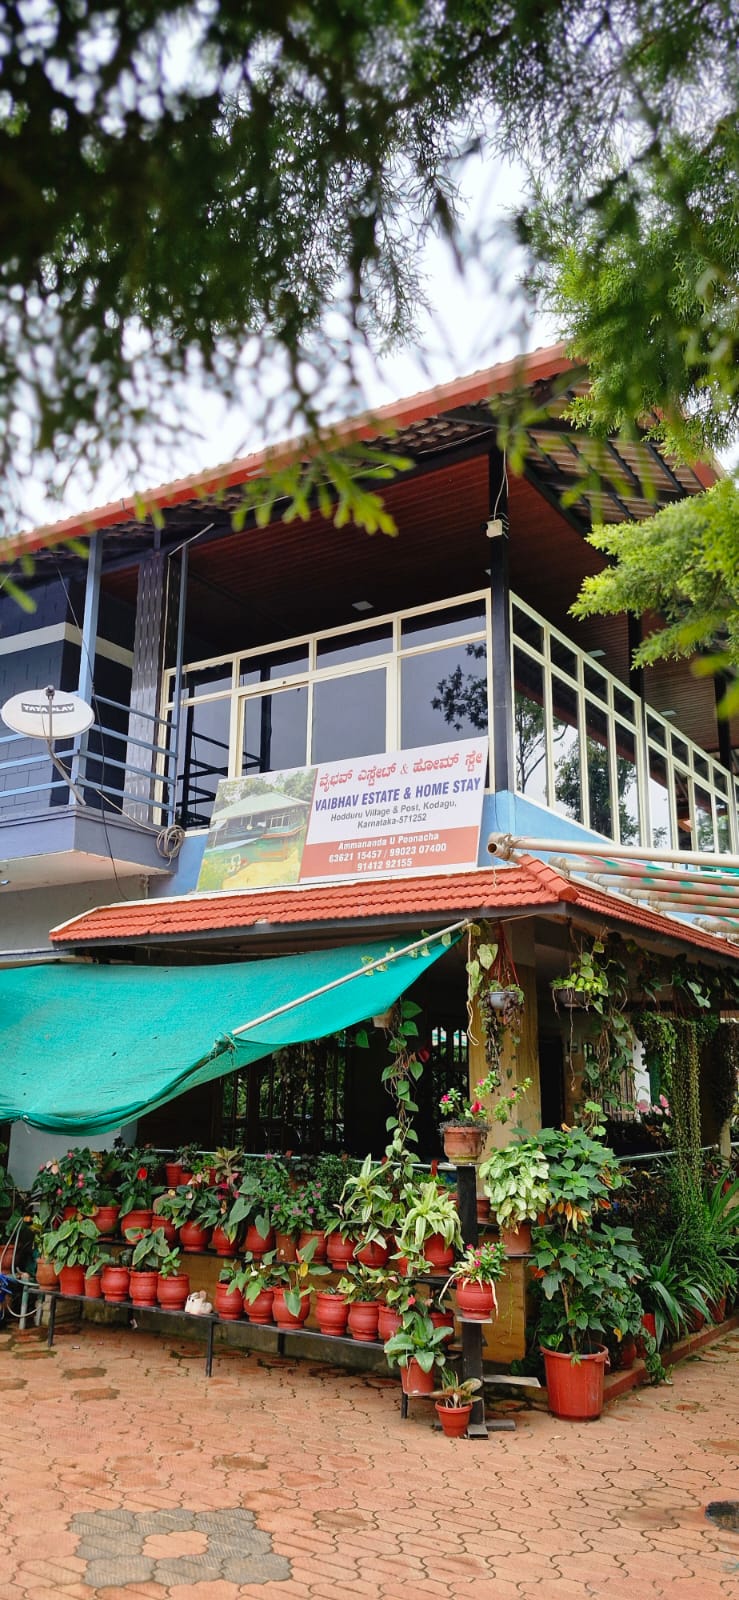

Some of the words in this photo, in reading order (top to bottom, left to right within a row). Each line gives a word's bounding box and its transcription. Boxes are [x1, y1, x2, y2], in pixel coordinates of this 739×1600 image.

[315, 794, 359, 812] VAIBHAV
[361, 788, 400, 806] ESTATE
[403, 786, 411, 800] &
[415, 781, 449, 798] HOME
[452, 777, 480, 794] STAY
[330, 812, 363, 822] Hodduru
[365, 808, 390, 818] Village
[400, 803, 421, 813] Post,
[423, 799, 457, 810] Kodagu,
[357, 813, 427, 829] Karnataka-571252
[389, 836, 396, 845] U
[357, 849, 382, 861] 15457
[389, 845, 416, 857] 99023
[418, 842, 447, 854] 07400
[356, 860, 383, 872] 91412
[385, 857, 413, 869] 92155
